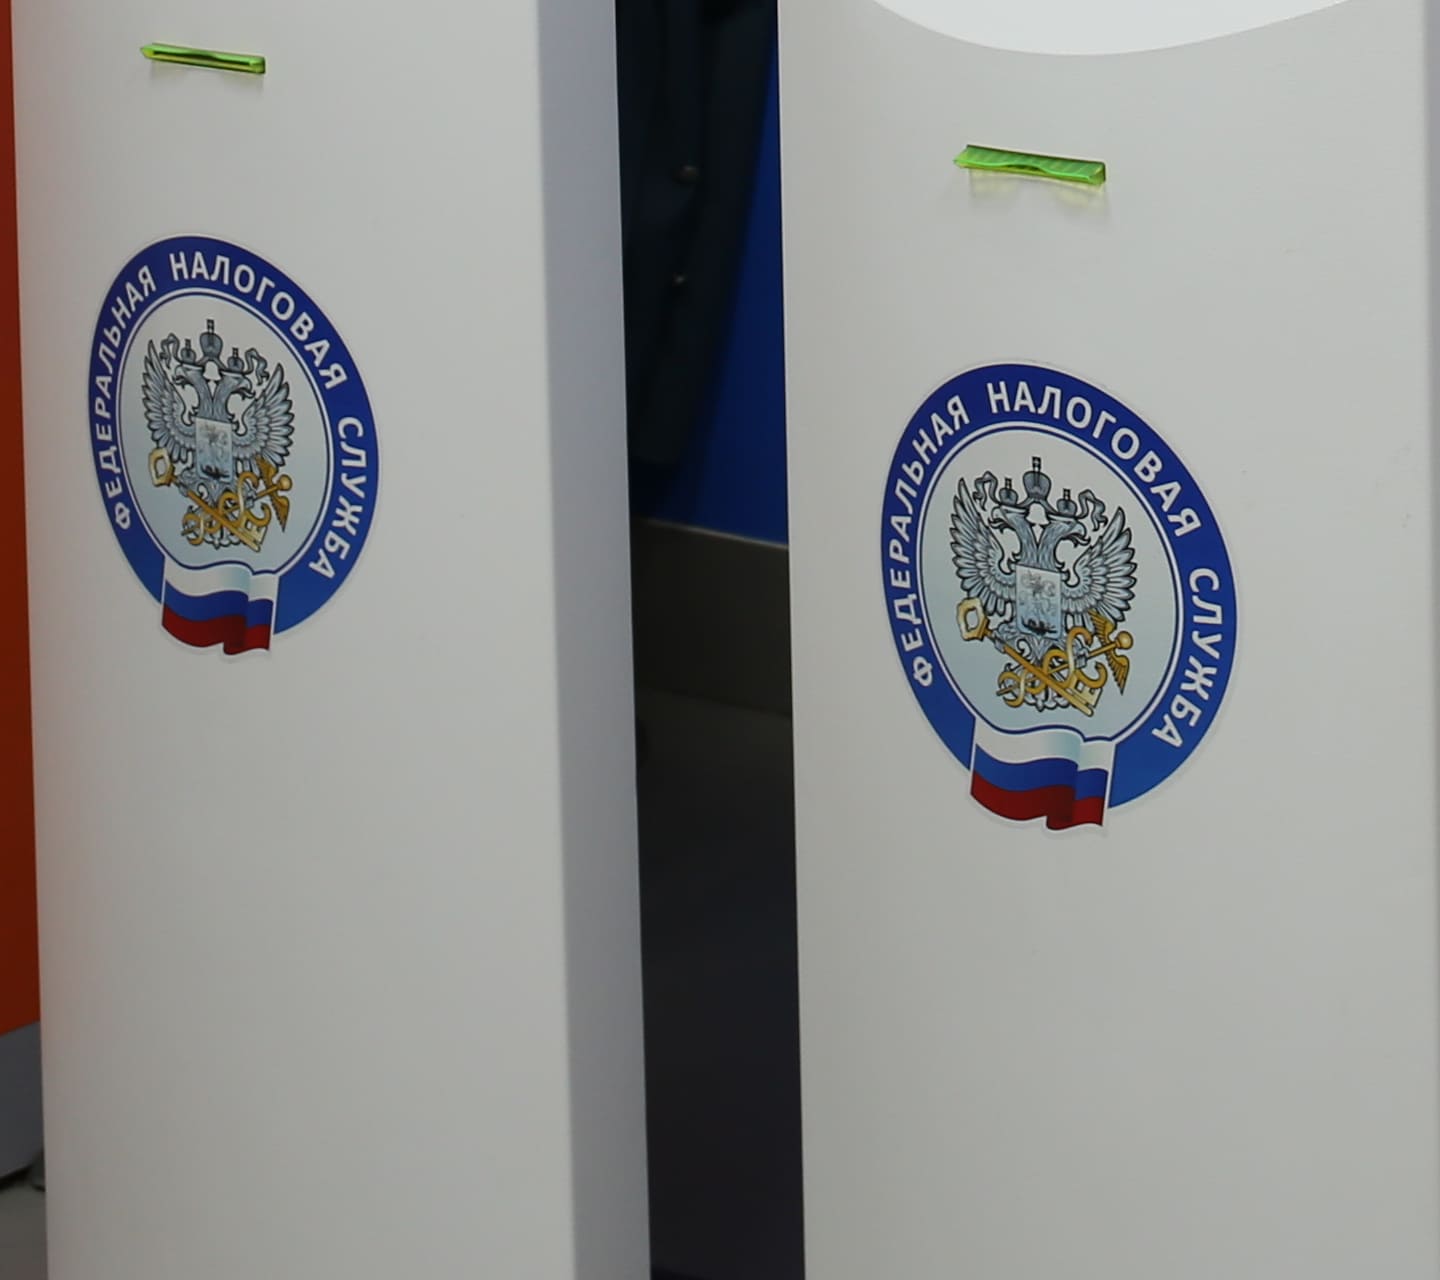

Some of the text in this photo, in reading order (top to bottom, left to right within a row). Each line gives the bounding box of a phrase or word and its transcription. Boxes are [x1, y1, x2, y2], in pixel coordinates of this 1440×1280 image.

[94, 251, 369, 580] ФЕДЕРАЛЬНАЯ НАЛОГОВАЯ СЛУЖБА
[889, 380, 1224, 749] ФЕДЕРАЛЬНАЯ НАЛОГОВАЯ СЛУЖБА
